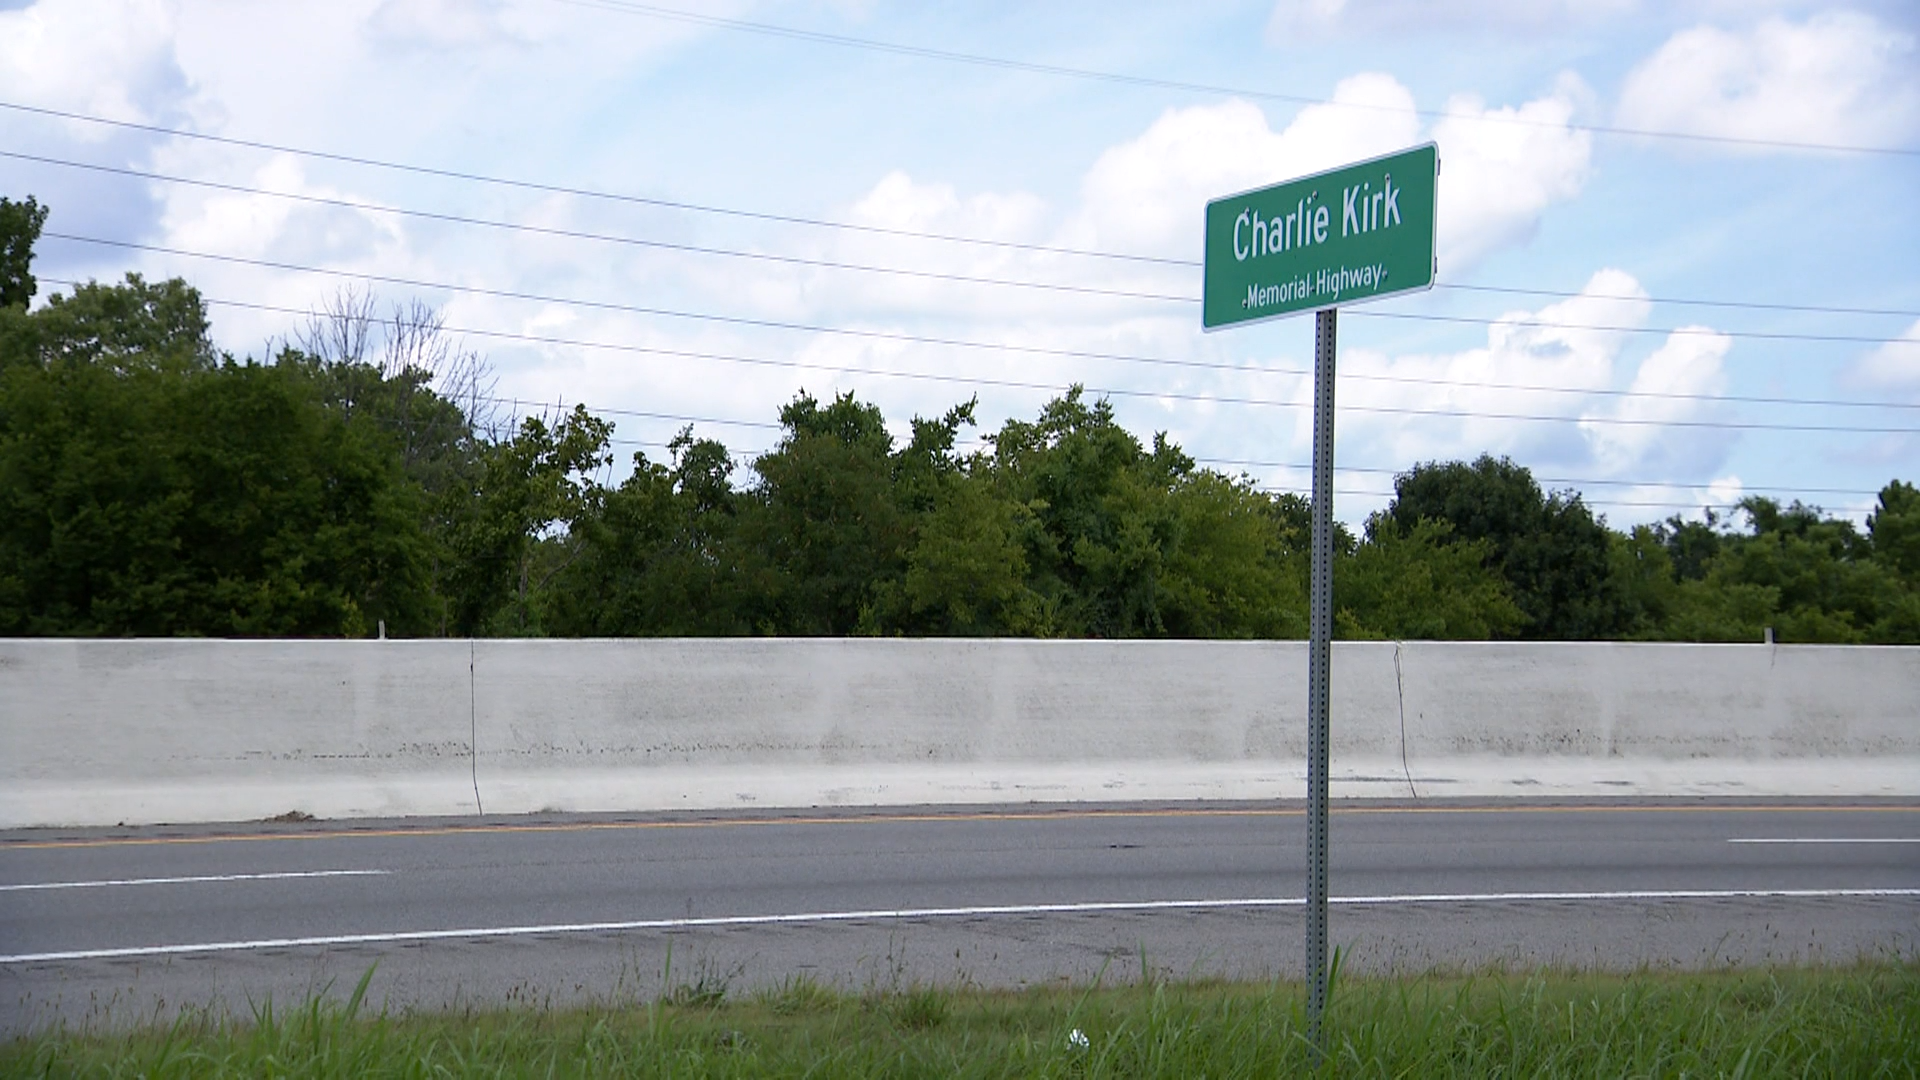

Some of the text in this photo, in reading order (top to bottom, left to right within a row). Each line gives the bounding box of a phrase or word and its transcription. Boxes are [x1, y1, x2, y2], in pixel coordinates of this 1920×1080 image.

[1233, 181, 1401, 261] Charlie Kirk
[1247, 263, 1382, 309] Memorial Highway
